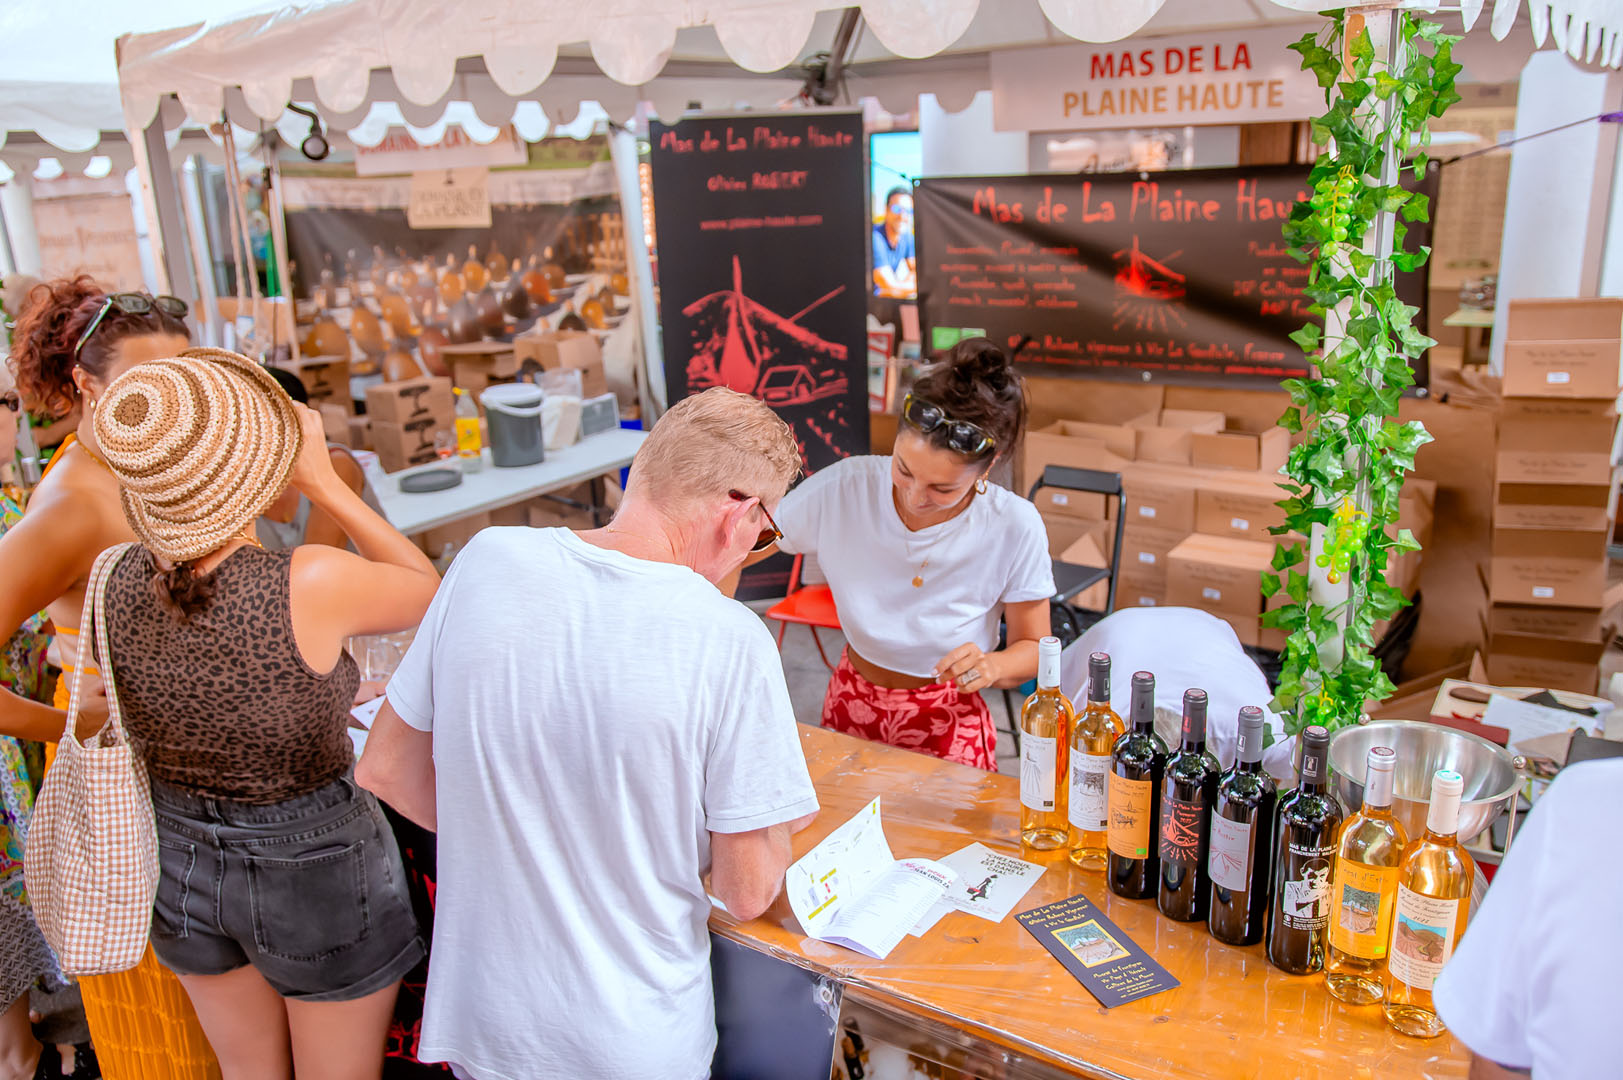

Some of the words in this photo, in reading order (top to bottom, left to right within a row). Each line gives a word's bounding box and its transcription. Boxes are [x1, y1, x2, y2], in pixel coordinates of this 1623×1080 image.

[1090, 50, 1154, 80] MAS
[1164, 46, 1204, 74] DE
[1213, 42, 1252, 71] LA
[1063, 86, 1168, 118] PLAINE
[1177, 80, 1284, 112] HAUTE
[660, 131, 694, 152] Mas
[700, 130, 720, 150] de
[726, 127, 747, 152] La
[753, 126, 801, 149] Plaine
[807, 125, 853, 147] Haute
[972, 185, 1024, 224] Mas
[1036, 187, 1068, 223] de
[1082, 181, 1115, 223] La
[1130, 180, 1224, 223] Plaine
